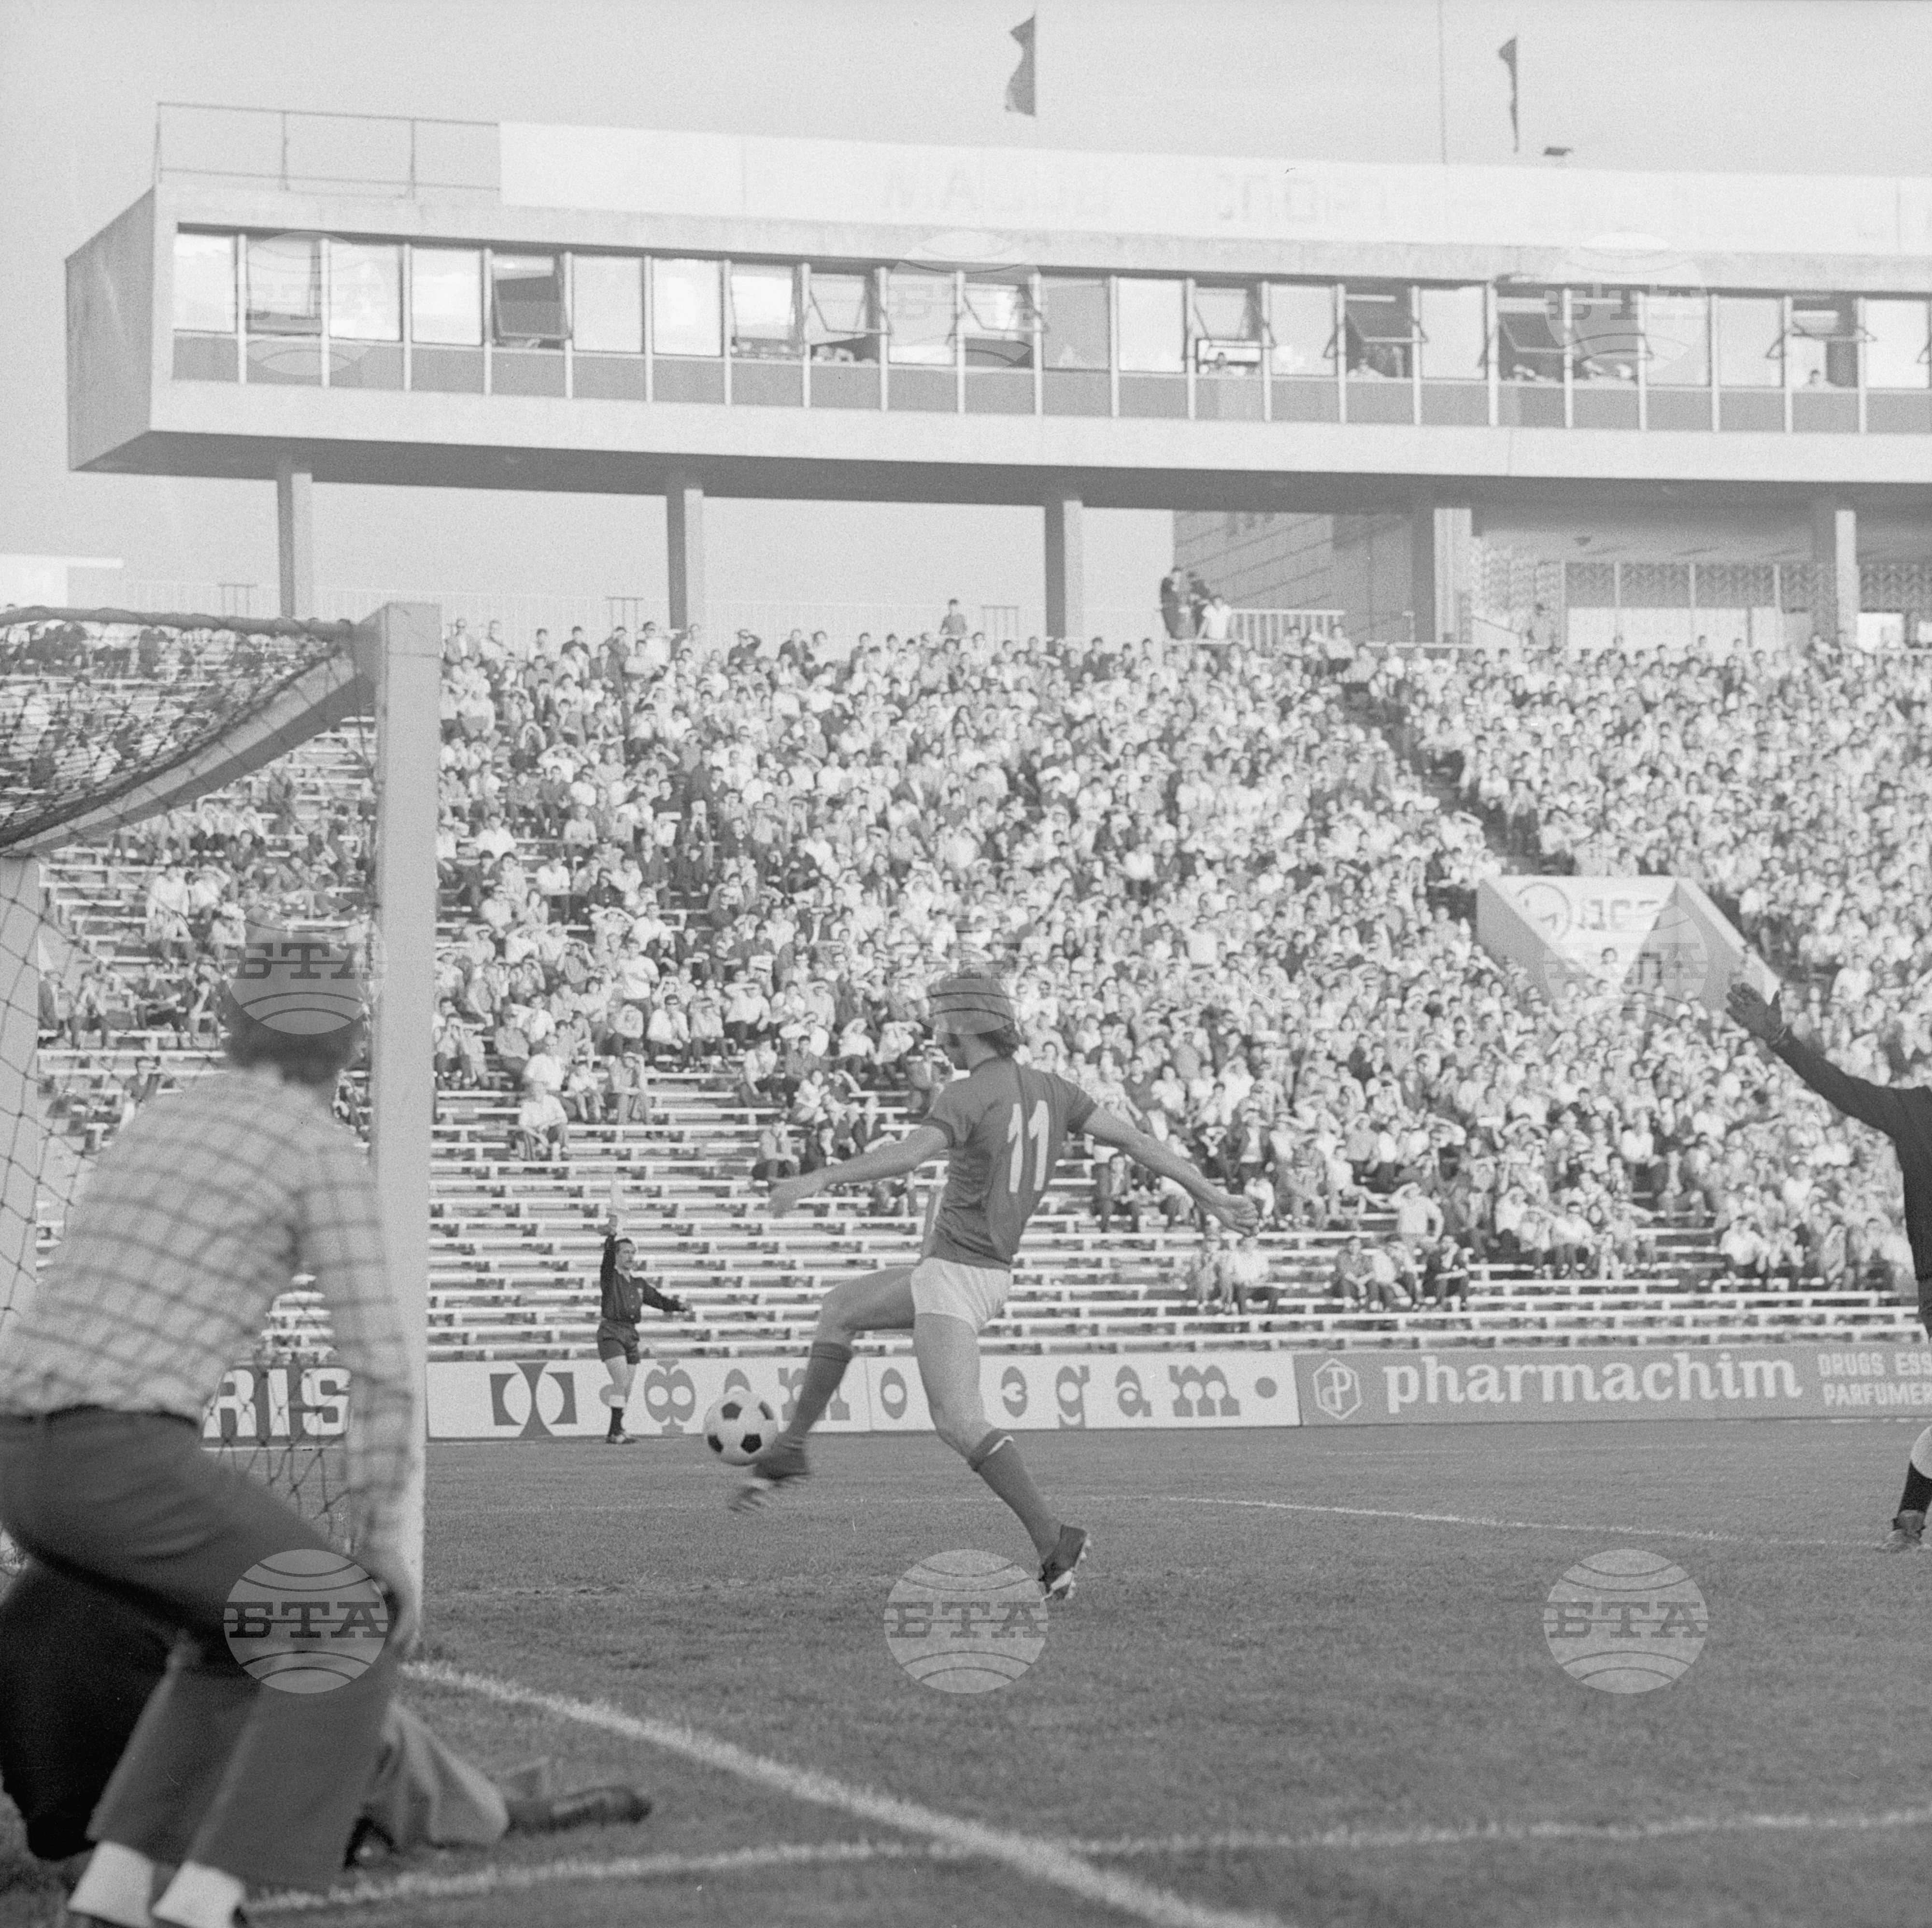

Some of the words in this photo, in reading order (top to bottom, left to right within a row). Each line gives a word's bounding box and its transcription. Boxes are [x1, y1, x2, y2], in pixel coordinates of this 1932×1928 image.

[1008, 1100, 1050, 1193] 11
[1382, 1352, 1804, 1414] pharmachim
[1817, 1352, 1885, 1377] DRUGS
